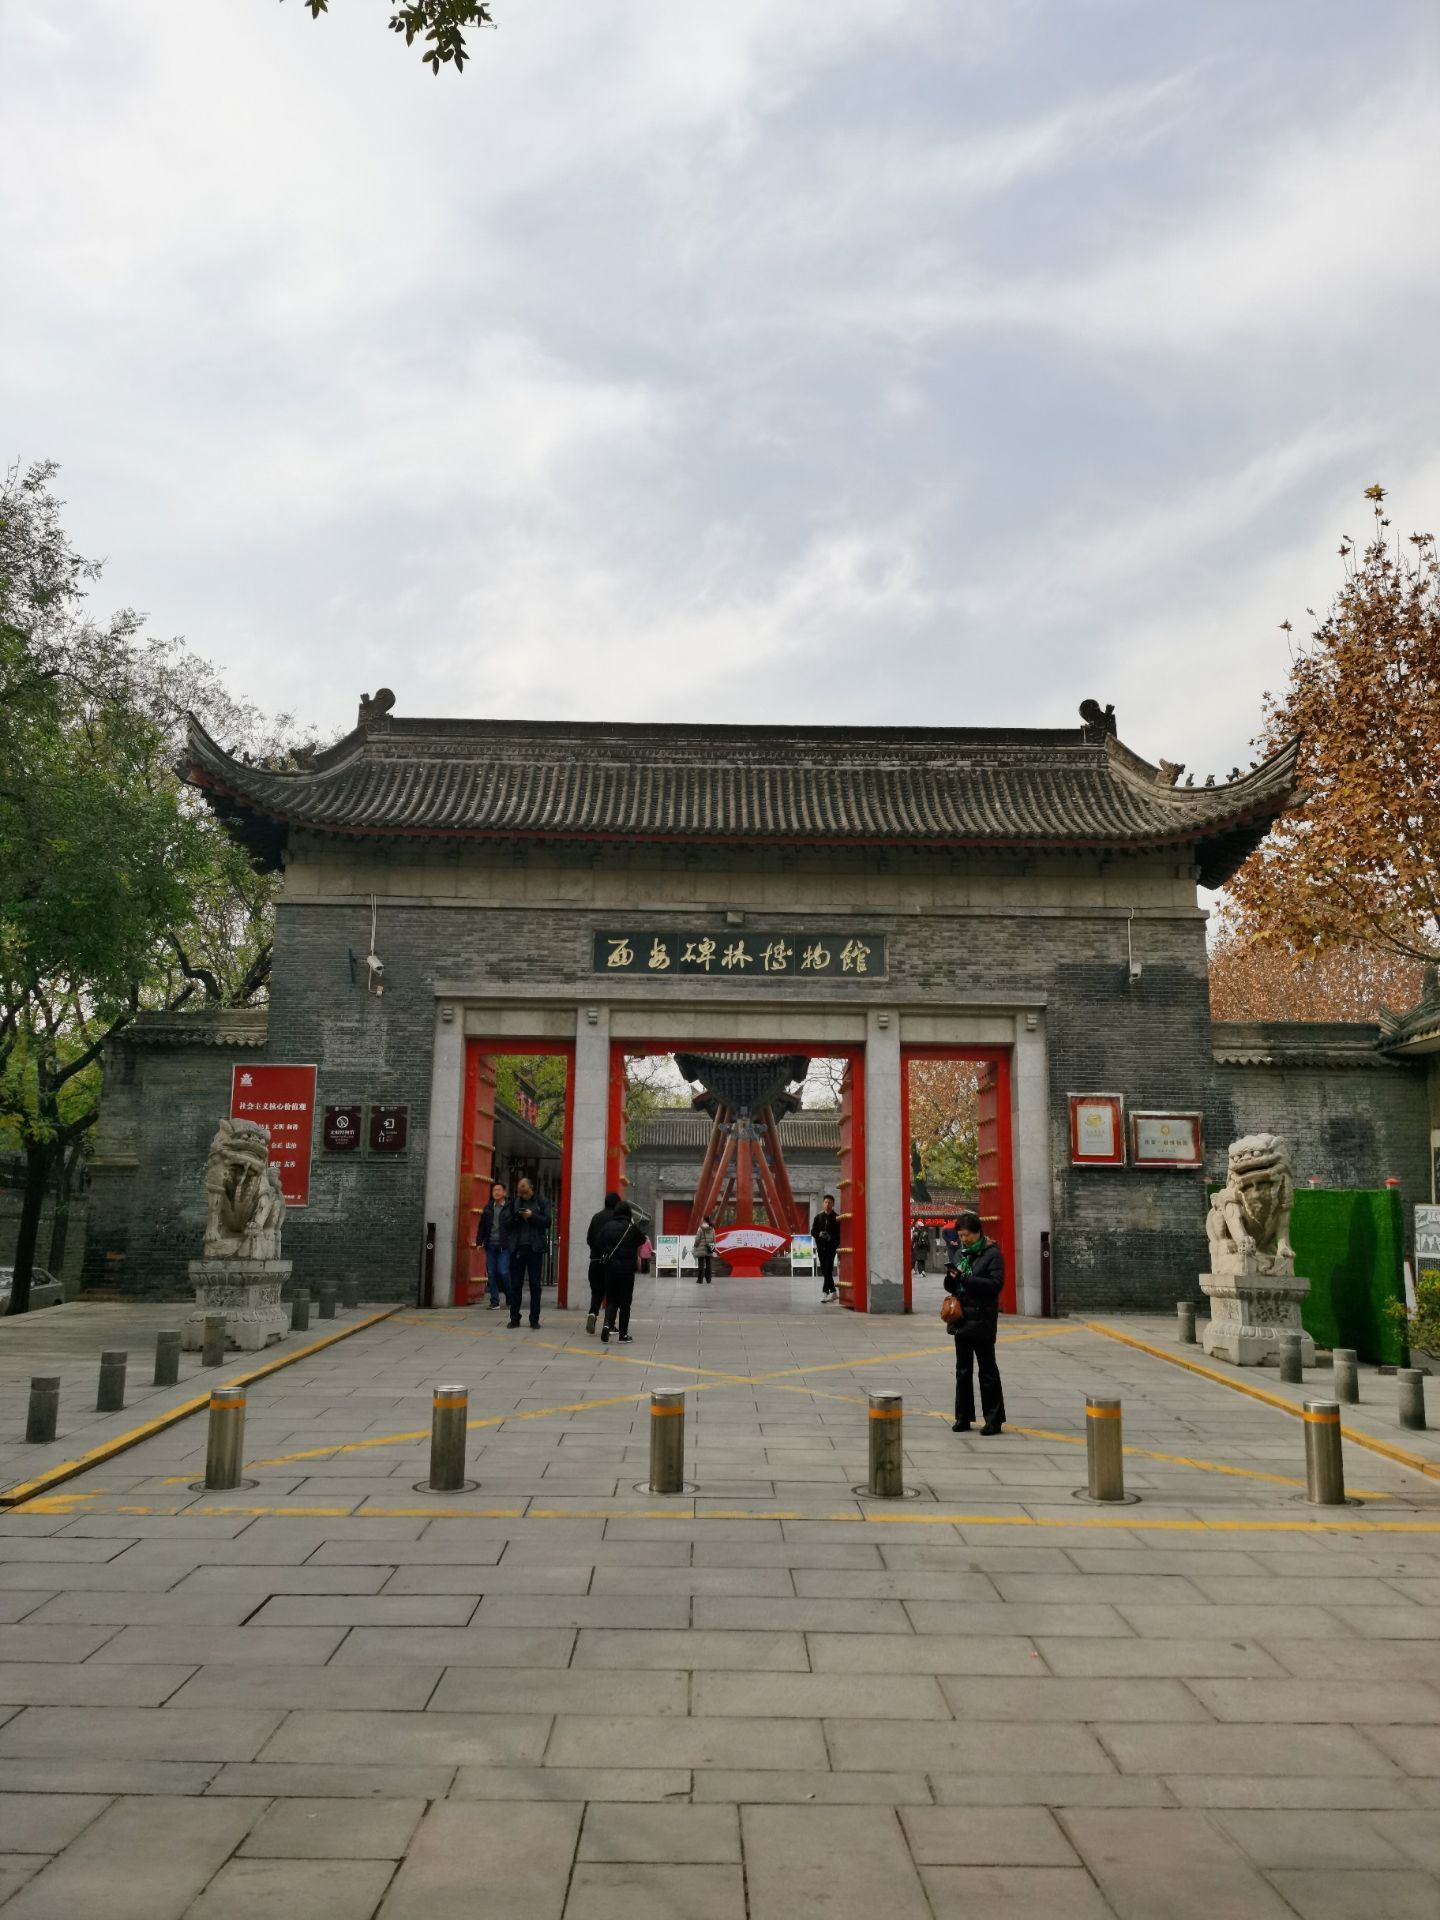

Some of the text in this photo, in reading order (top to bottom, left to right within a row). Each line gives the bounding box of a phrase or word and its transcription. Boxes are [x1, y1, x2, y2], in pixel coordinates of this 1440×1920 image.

[239, 1102, 307, 1111] 社会主义核心价值观
